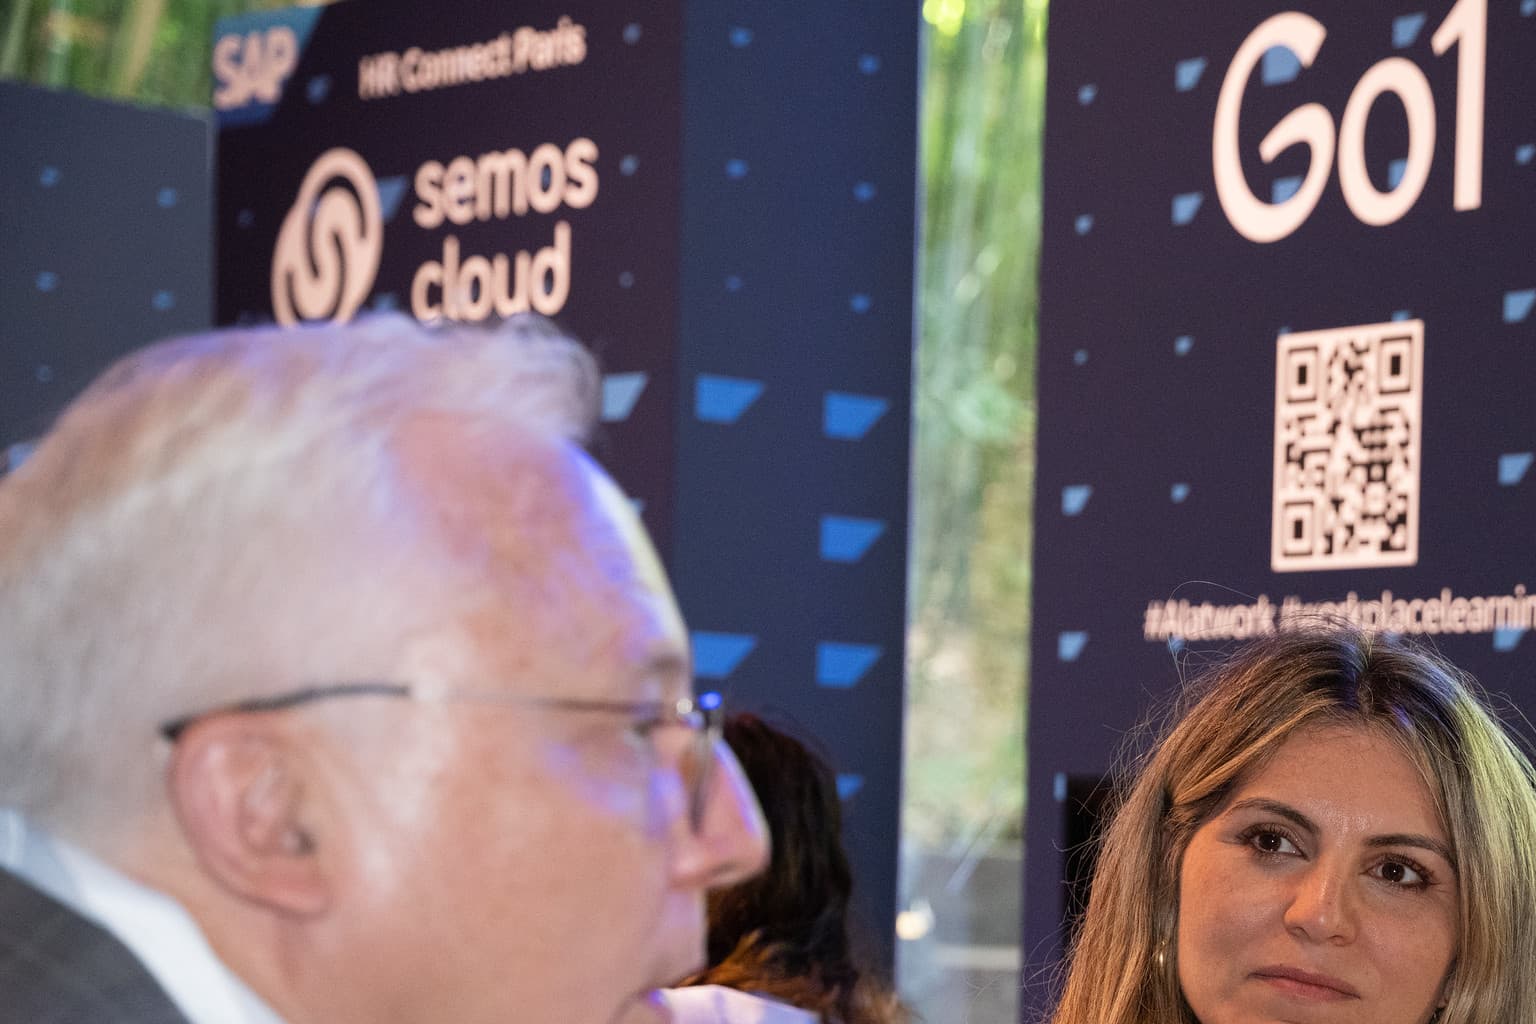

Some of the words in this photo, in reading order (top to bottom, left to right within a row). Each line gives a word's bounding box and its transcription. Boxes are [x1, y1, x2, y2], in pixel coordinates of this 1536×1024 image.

[213, 26, 298, 110] SAP
[359, 52, 400, 100] HR
[401, 45, 512, 93] Connect
[512, 15, 588, 74] Paris
[1212, 0, 1488, 244] Go1
[412, 137, 600, 229] semos
[411, 220, 572, 323] cloud
